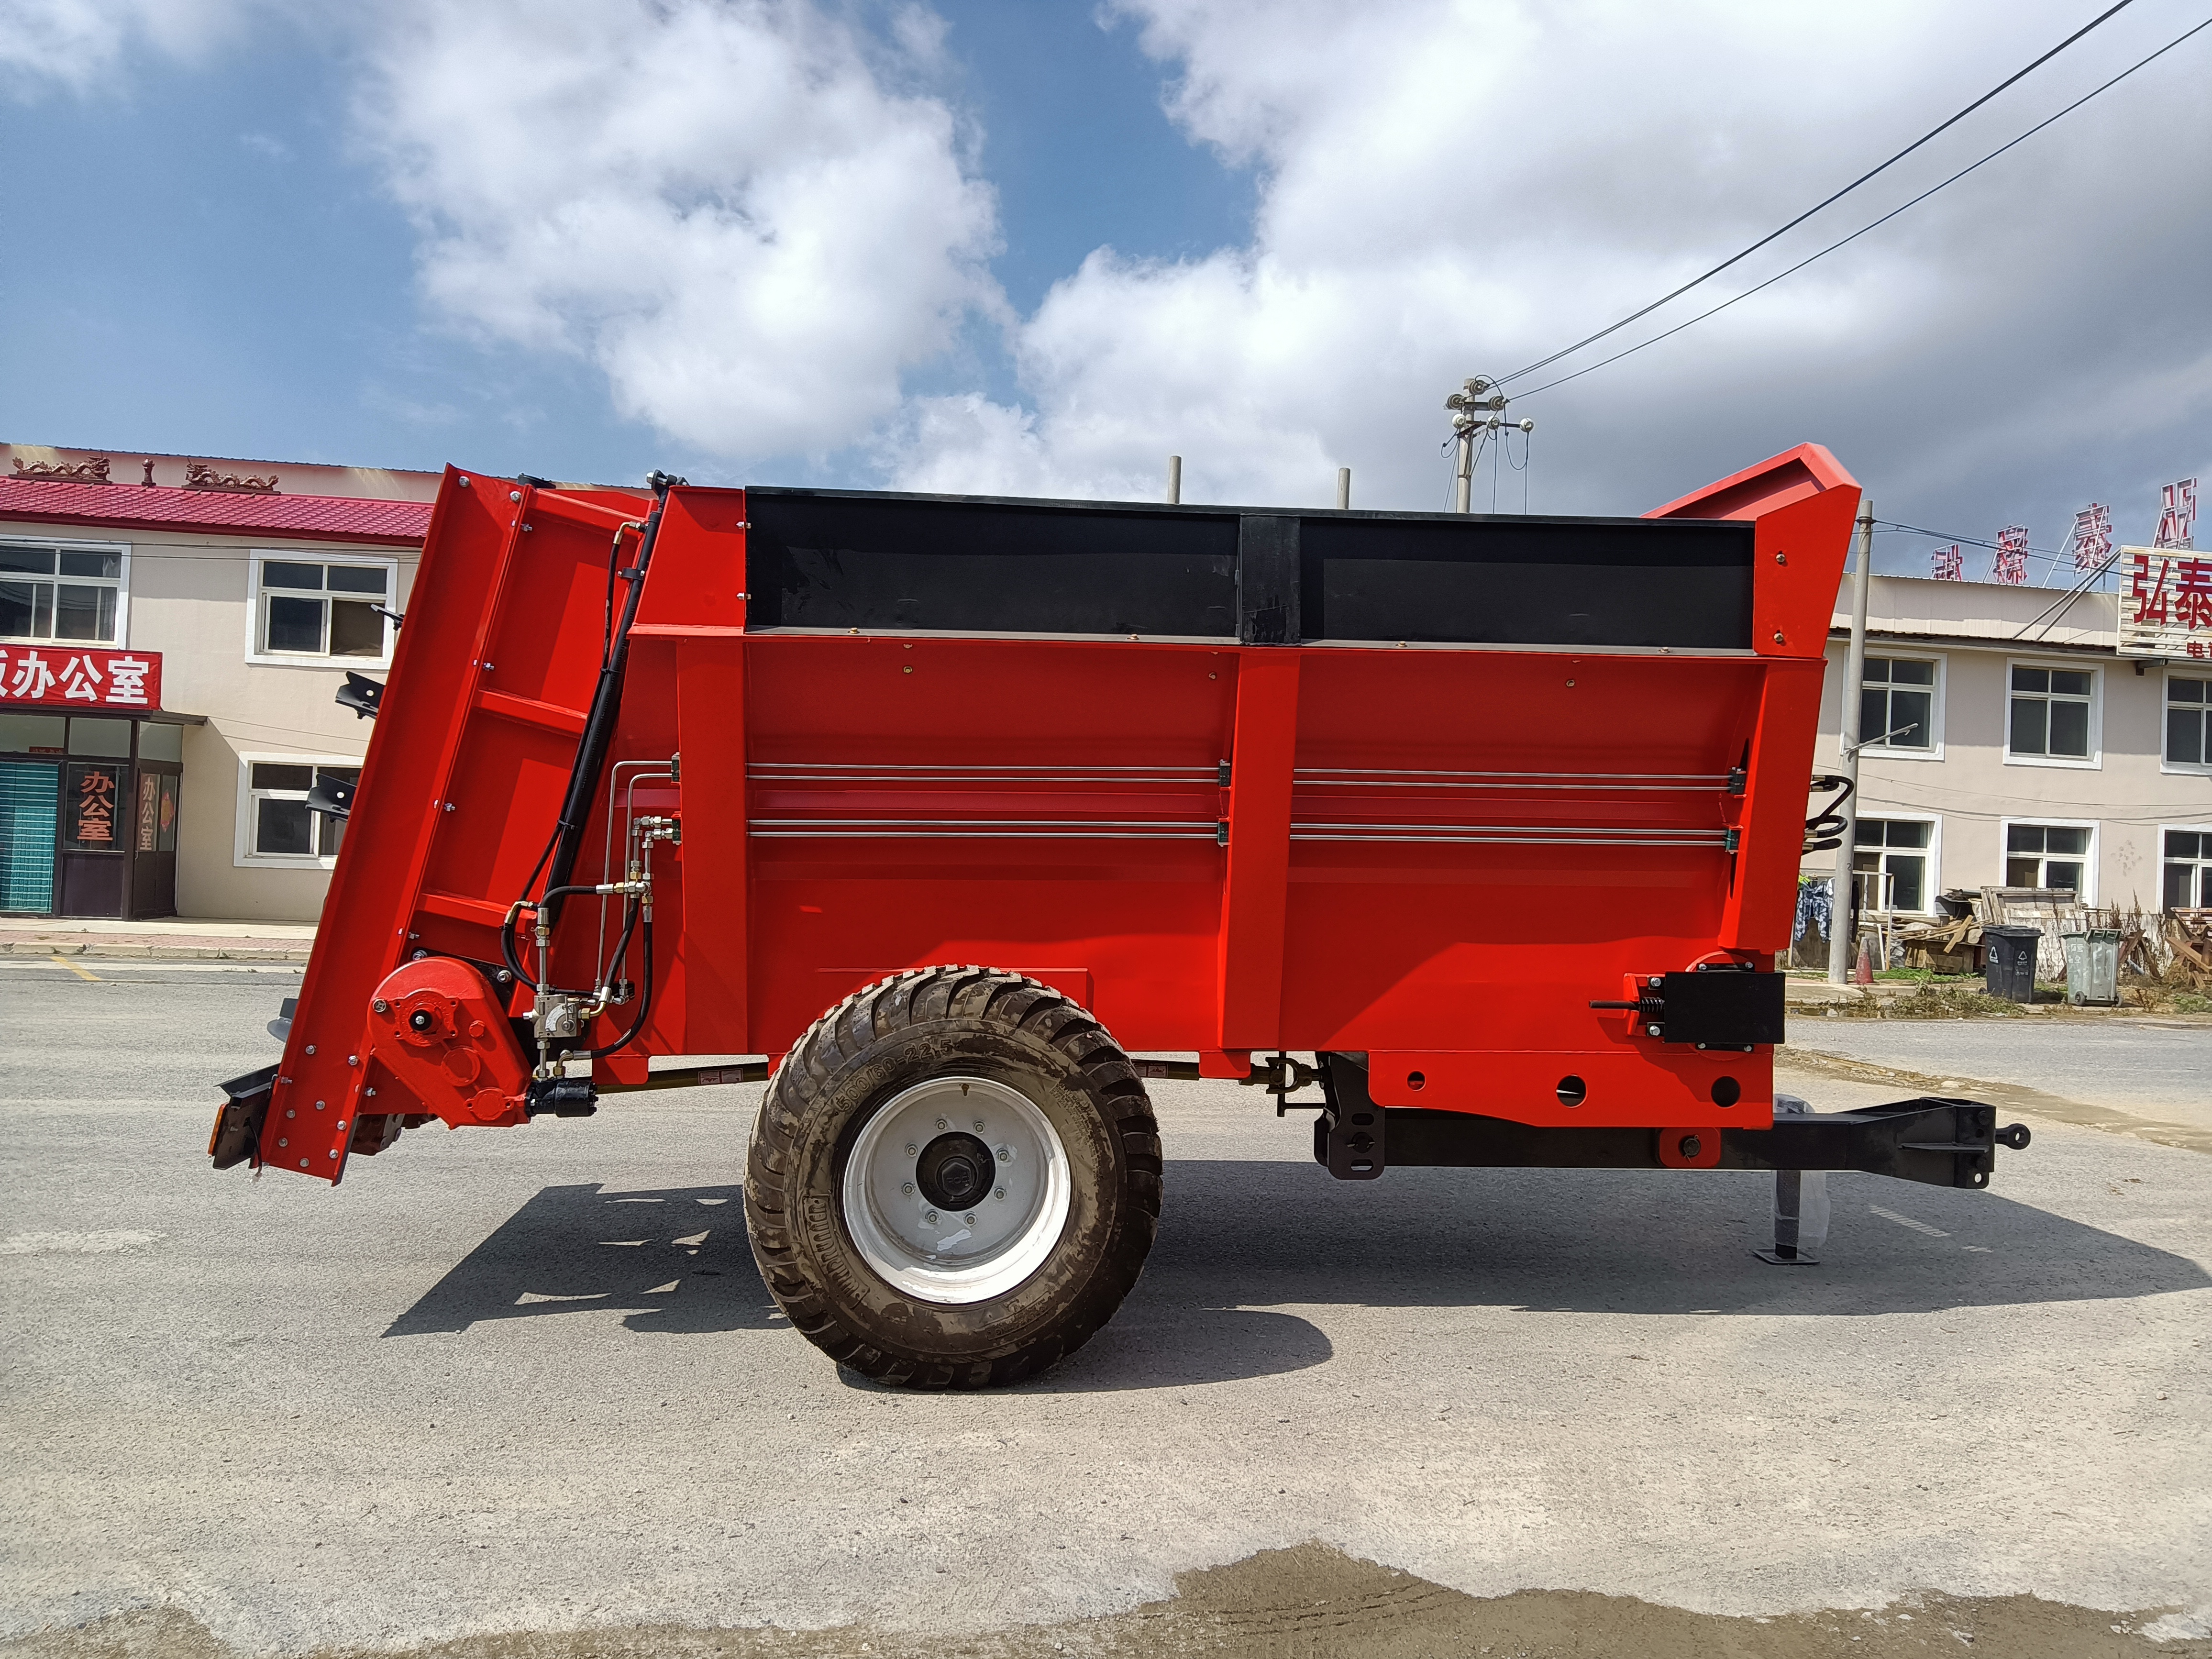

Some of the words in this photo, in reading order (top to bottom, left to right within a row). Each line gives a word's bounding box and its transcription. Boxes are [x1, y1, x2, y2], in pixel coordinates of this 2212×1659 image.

[2132, 554, 2212, 629] 弘泰
[77, 771, 115, 841] 办公室
[140, 776, 155, 851] 办公室
[836, 1039, 953, 1111] 500/60-22.5
